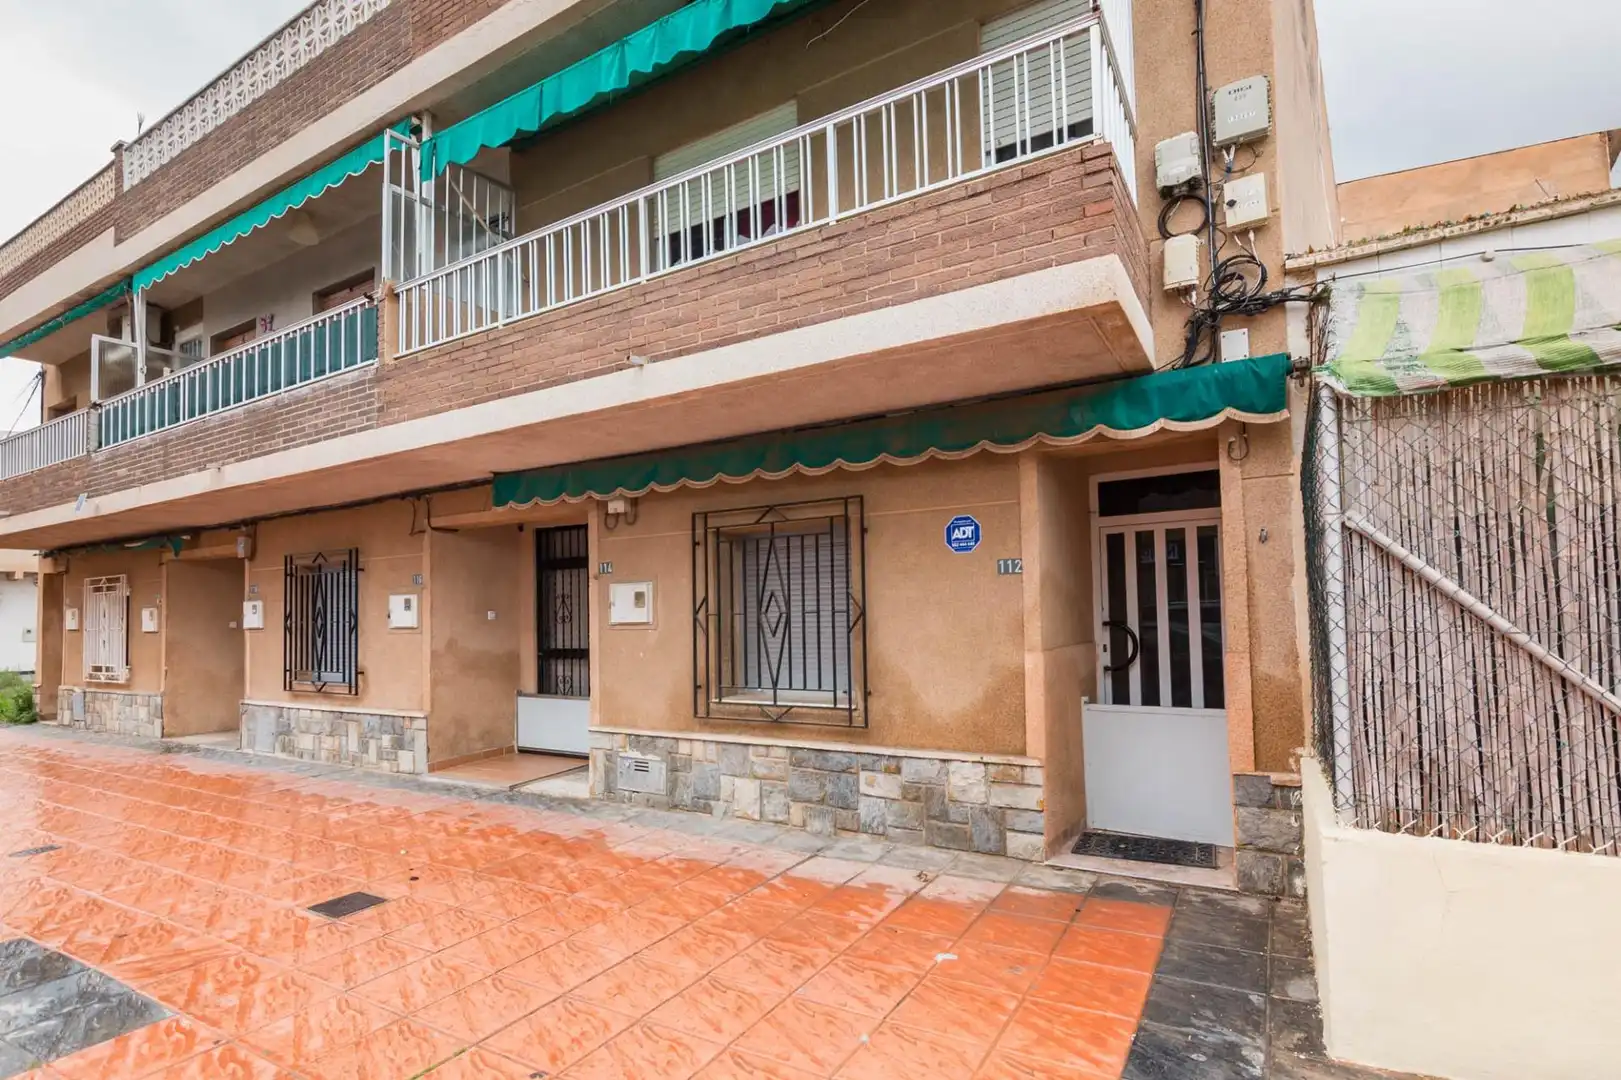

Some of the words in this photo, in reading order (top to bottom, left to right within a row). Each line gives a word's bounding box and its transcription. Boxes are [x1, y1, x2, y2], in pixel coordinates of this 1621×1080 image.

[952, 526, 974, 539] ADT
[599, 562, 612, 574] 114
[998, 559, 1022, 573] 112
